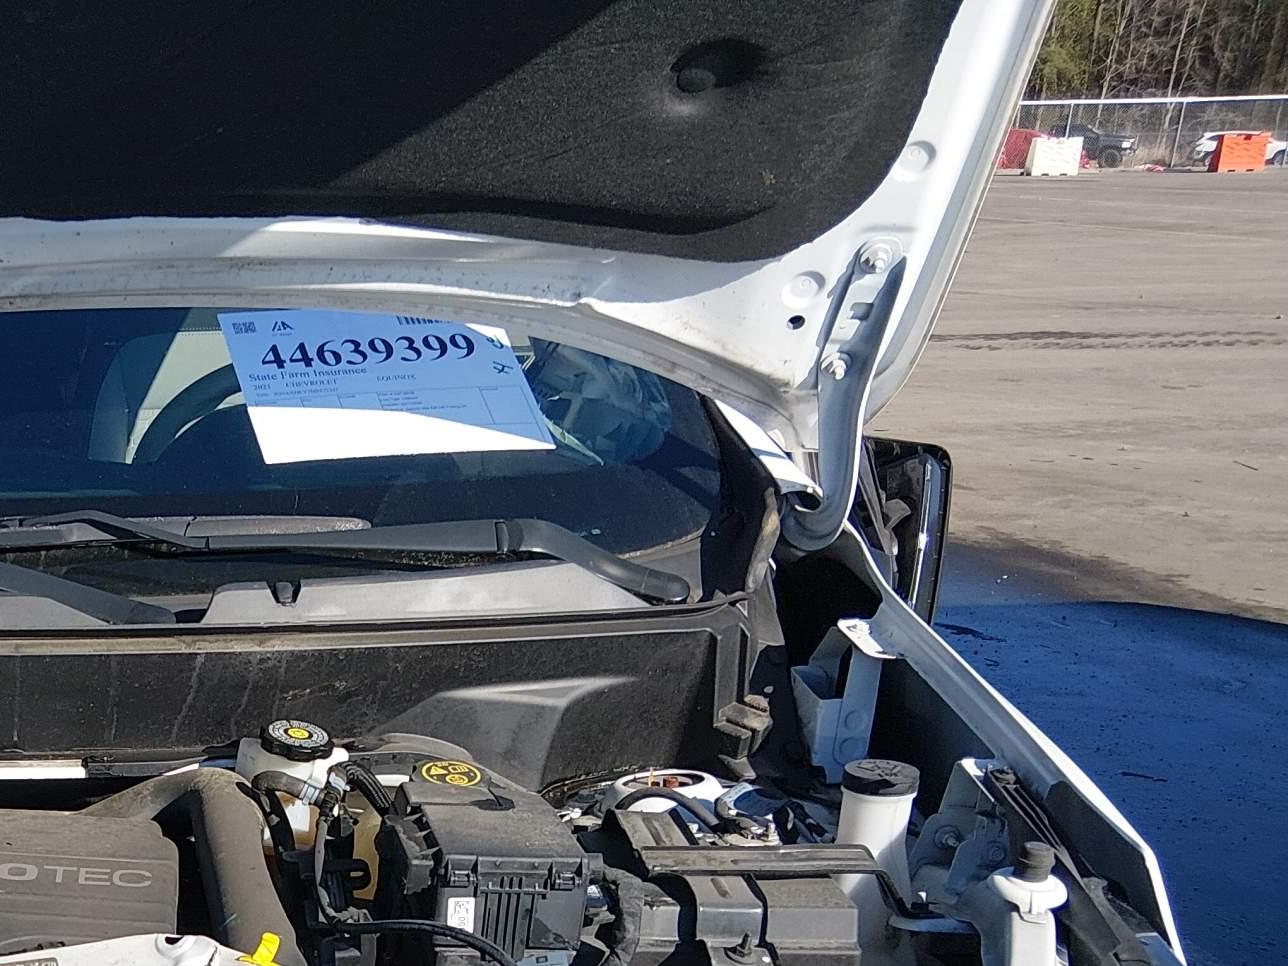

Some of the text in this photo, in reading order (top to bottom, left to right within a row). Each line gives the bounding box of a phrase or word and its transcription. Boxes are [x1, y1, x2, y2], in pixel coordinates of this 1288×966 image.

[262, 333, 475, 369] 44639399
[248, 367, 367, 382] State Farm Insurance
